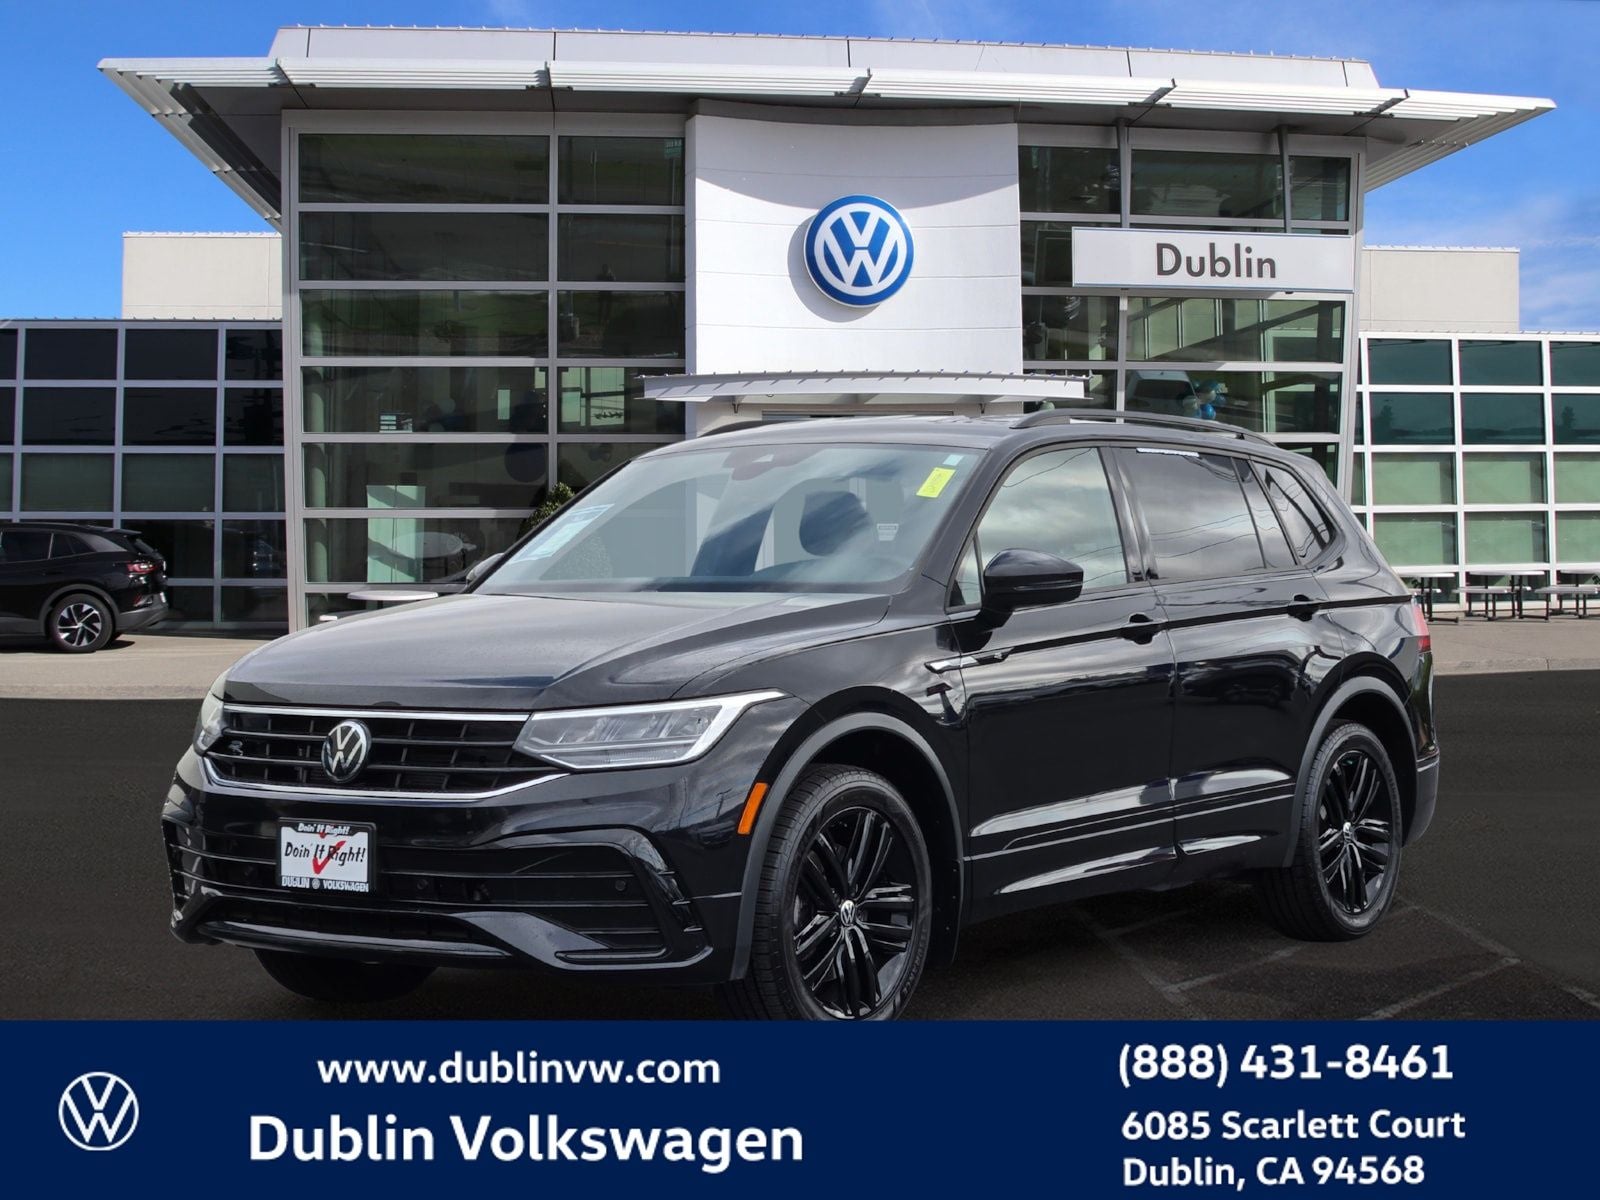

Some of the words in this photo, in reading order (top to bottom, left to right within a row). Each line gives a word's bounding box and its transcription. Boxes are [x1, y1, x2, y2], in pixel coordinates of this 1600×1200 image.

[1156, 242, 1276, 279] Dublin
[325, 825, 350, 837] Right!
[314, 844, 325, 860] It
[327, 845, 366, 867] Right!
[281, 876, 310, 889] DUBLIN
[323, 880, 369, 893] VOLKSWAGEN
